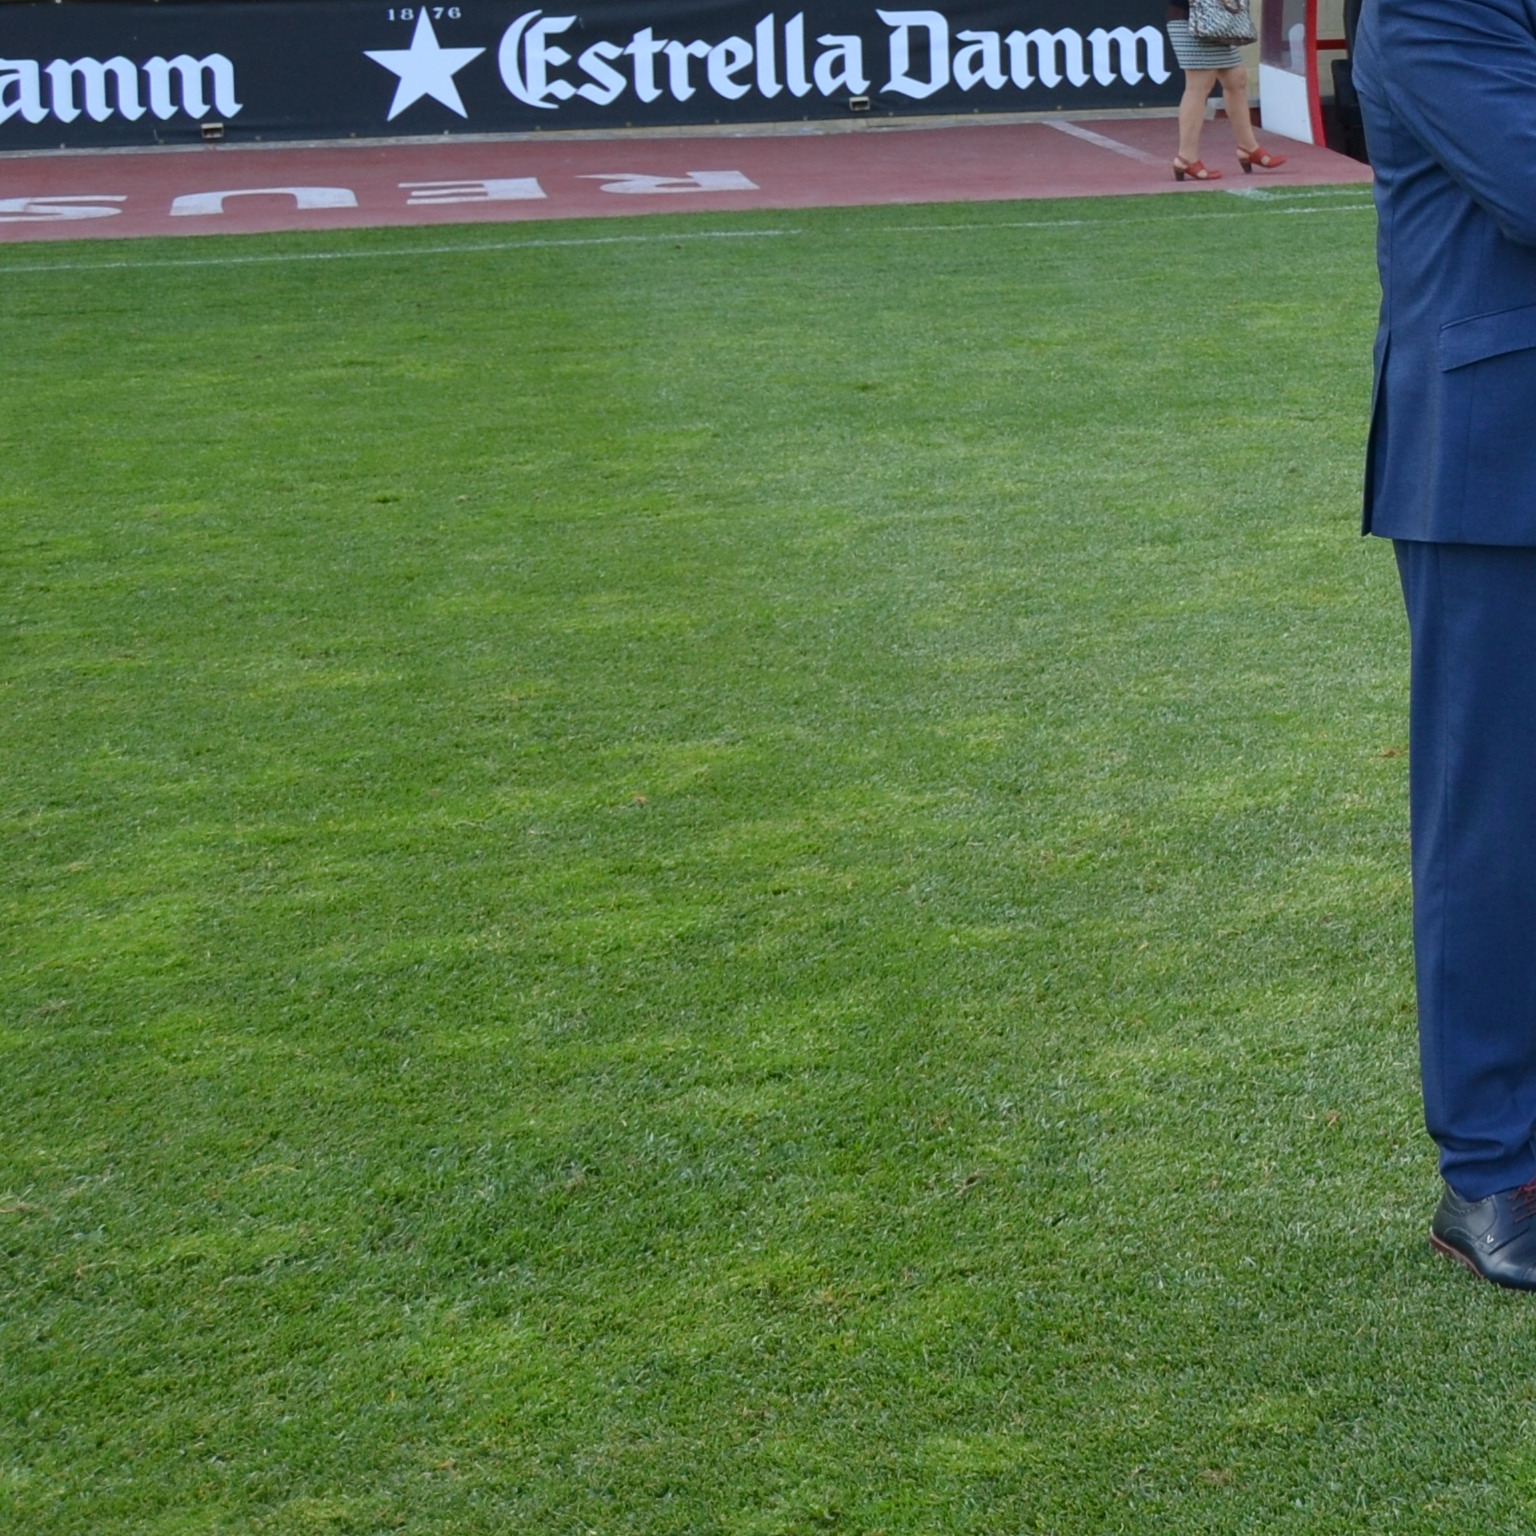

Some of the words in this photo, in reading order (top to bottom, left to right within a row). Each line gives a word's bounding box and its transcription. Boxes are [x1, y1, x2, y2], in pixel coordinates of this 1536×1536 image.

[387, 7, 414, 22] 18
[432, 6, 462, 20] 76
[0, 53, 243, 125] amm
[498, 9, 870, 110] Estrella
[876, 9, 1171, 100] Damm
